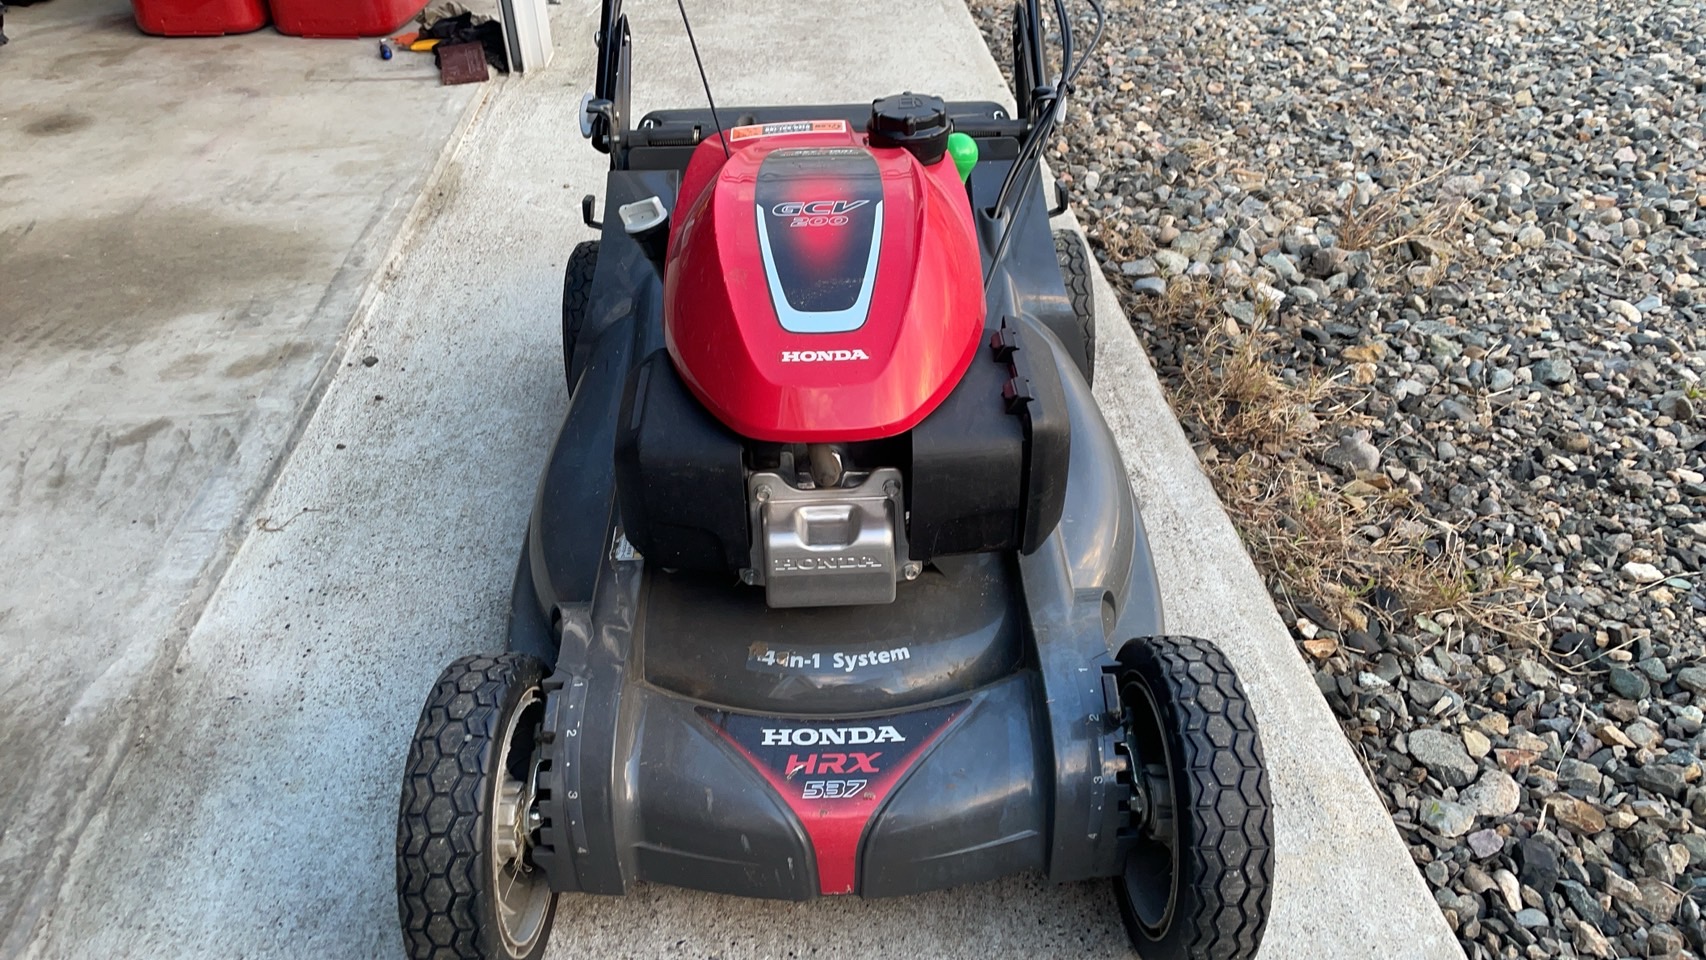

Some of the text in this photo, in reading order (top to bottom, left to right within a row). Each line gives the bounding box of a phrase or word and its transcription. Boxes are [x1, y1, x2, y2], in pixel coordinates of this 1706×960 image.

[772, 200, 870, 216] GCV
[790, 216, 848, 227] 200
[781, 349, 869, 362] HONDA
[775, 556, 882, 571] HONDA
[833, 646, 911, 672] System
[1089, 713, 1099, 722] 2
[566, 729, 577, 738] 2
[761, 726, 906, 746] HONDA
[785, 752, 882, 775] HRX
[1093, 776, 1103, 784] 3
[568, 790, 578, 799] 3
[802, 779, 867, 799] 537
